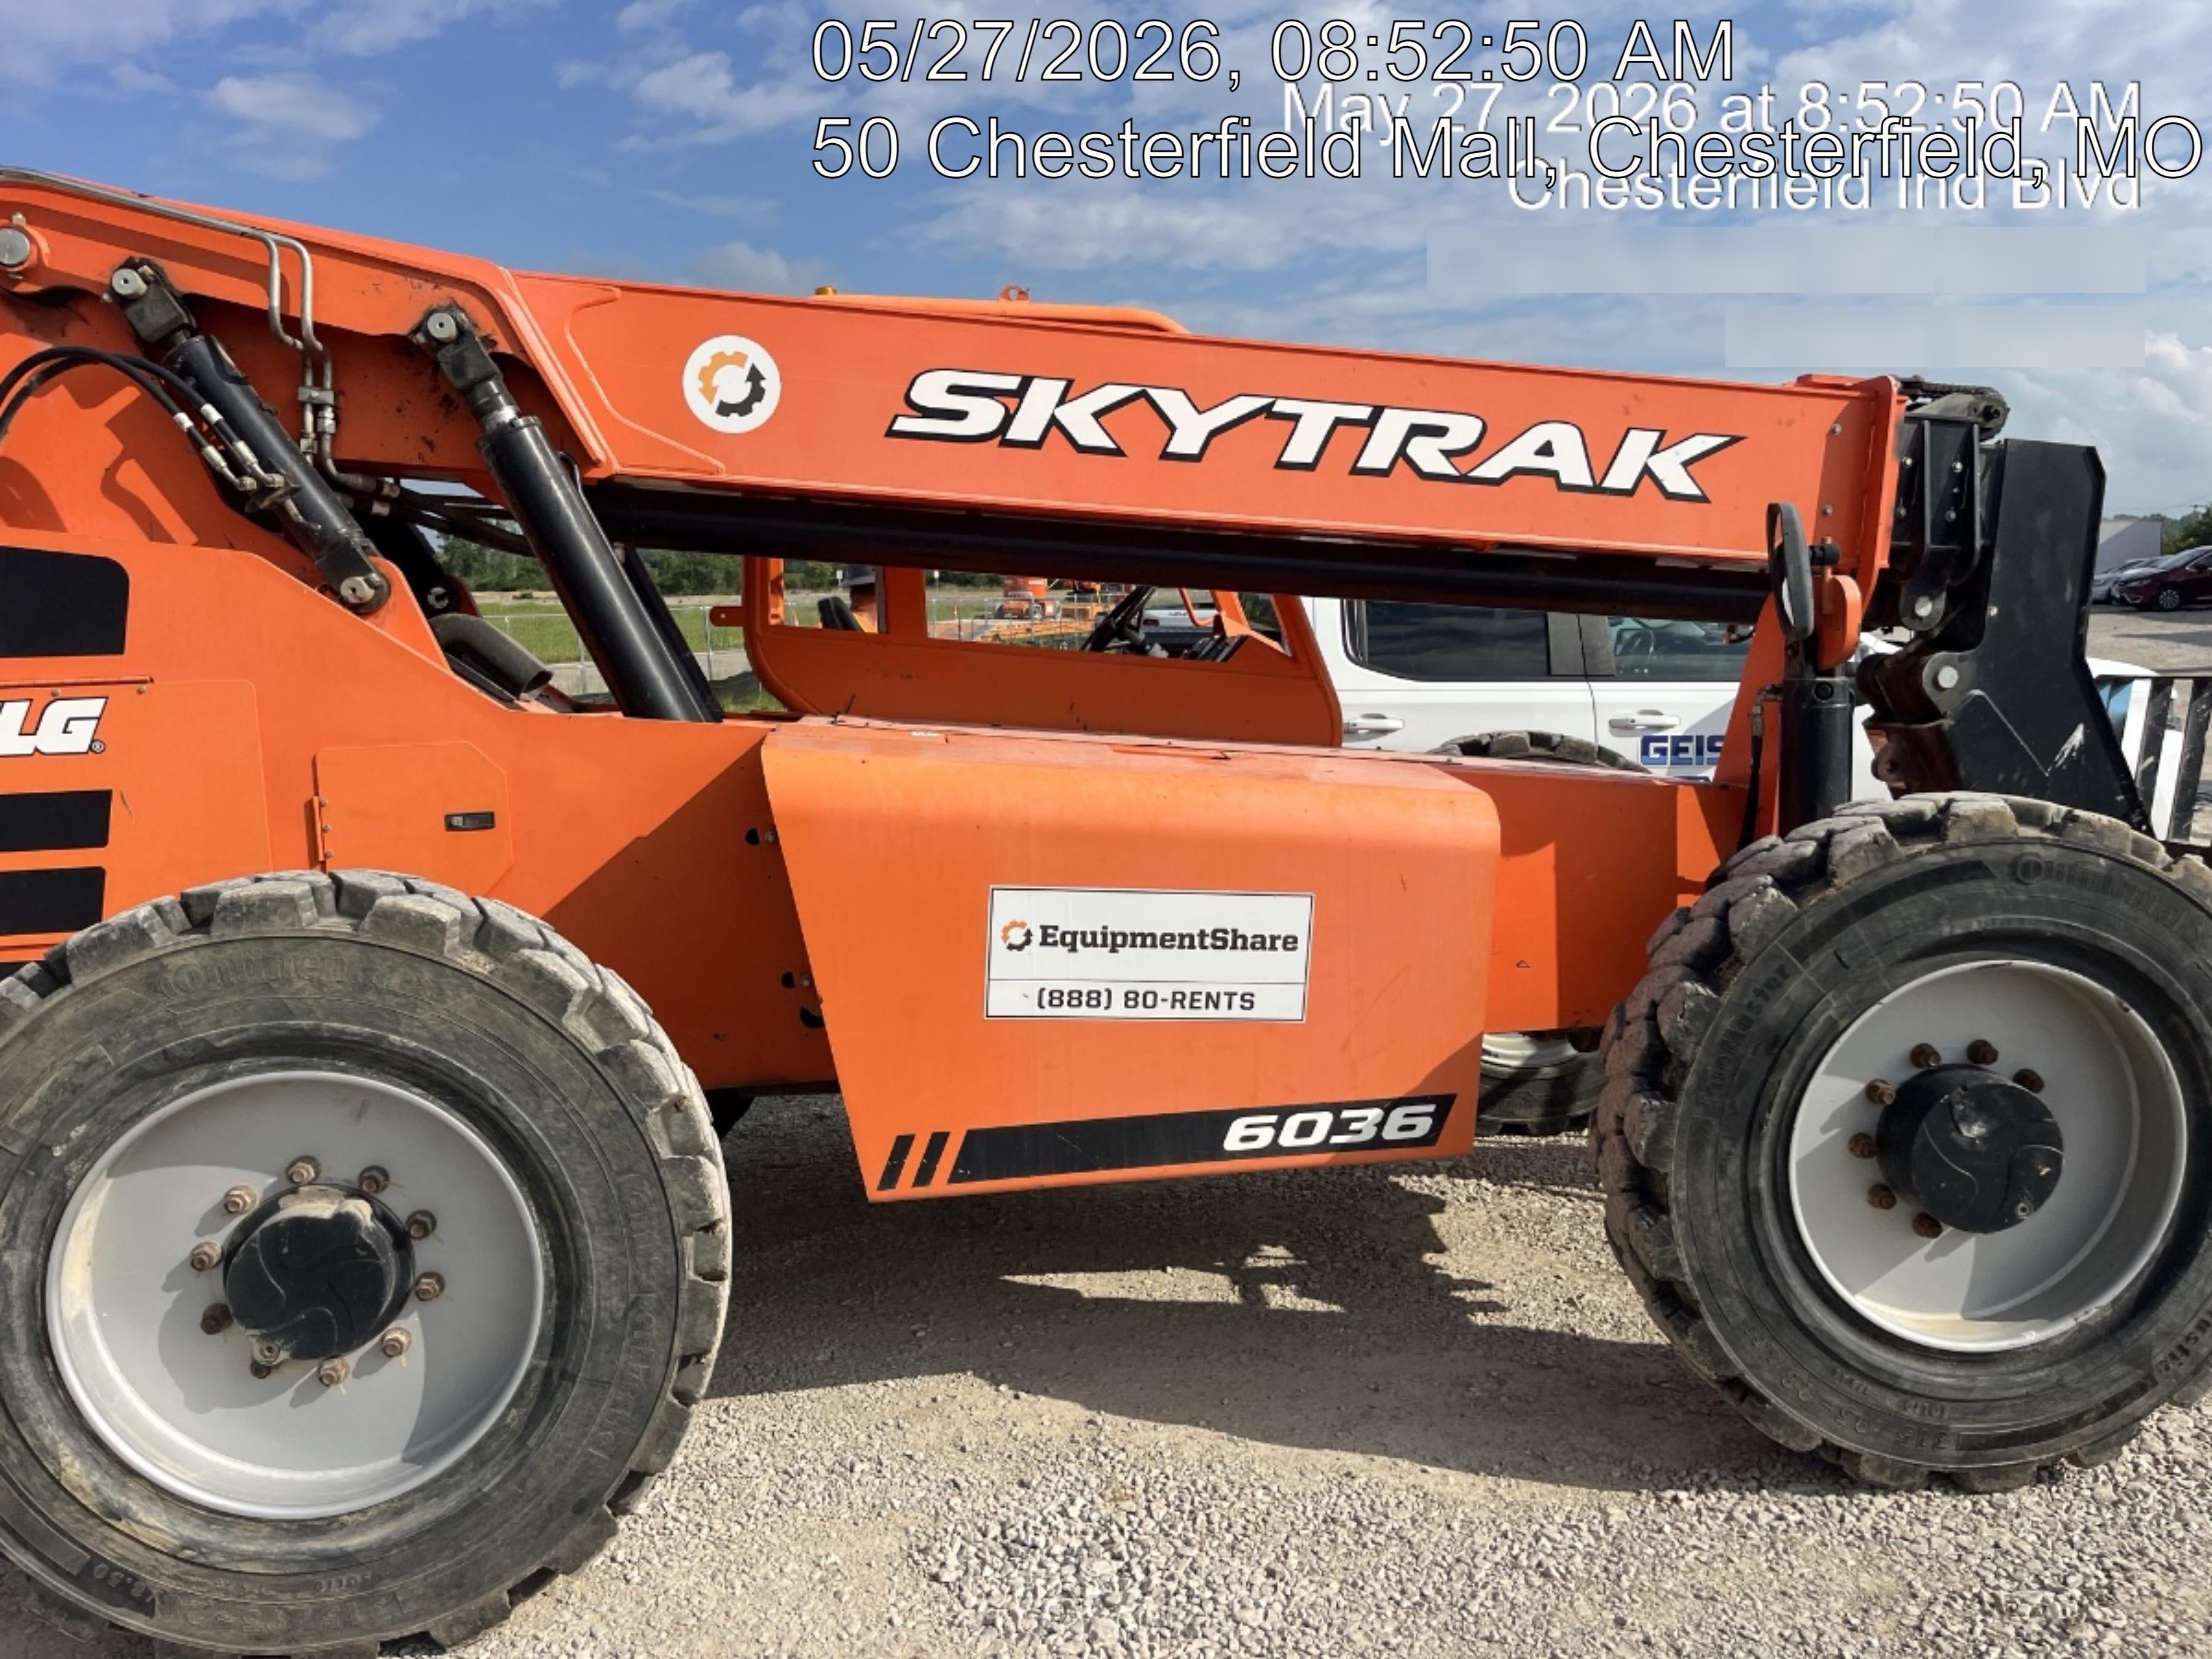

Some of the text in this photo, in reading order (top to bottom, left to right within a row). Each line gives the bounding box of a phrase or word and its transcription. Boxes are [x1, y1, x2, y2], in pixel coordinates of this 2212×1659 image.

[884, 368, 1746, 504] SKYTRAK
[0, 696, 109, 757] LG
[1039, 925, 1299, 953] EquipmentShare
[1037, 987, 1256, 1011] (888) 80-RENTS
[1223, 1104, 1437, 1151] 6036
